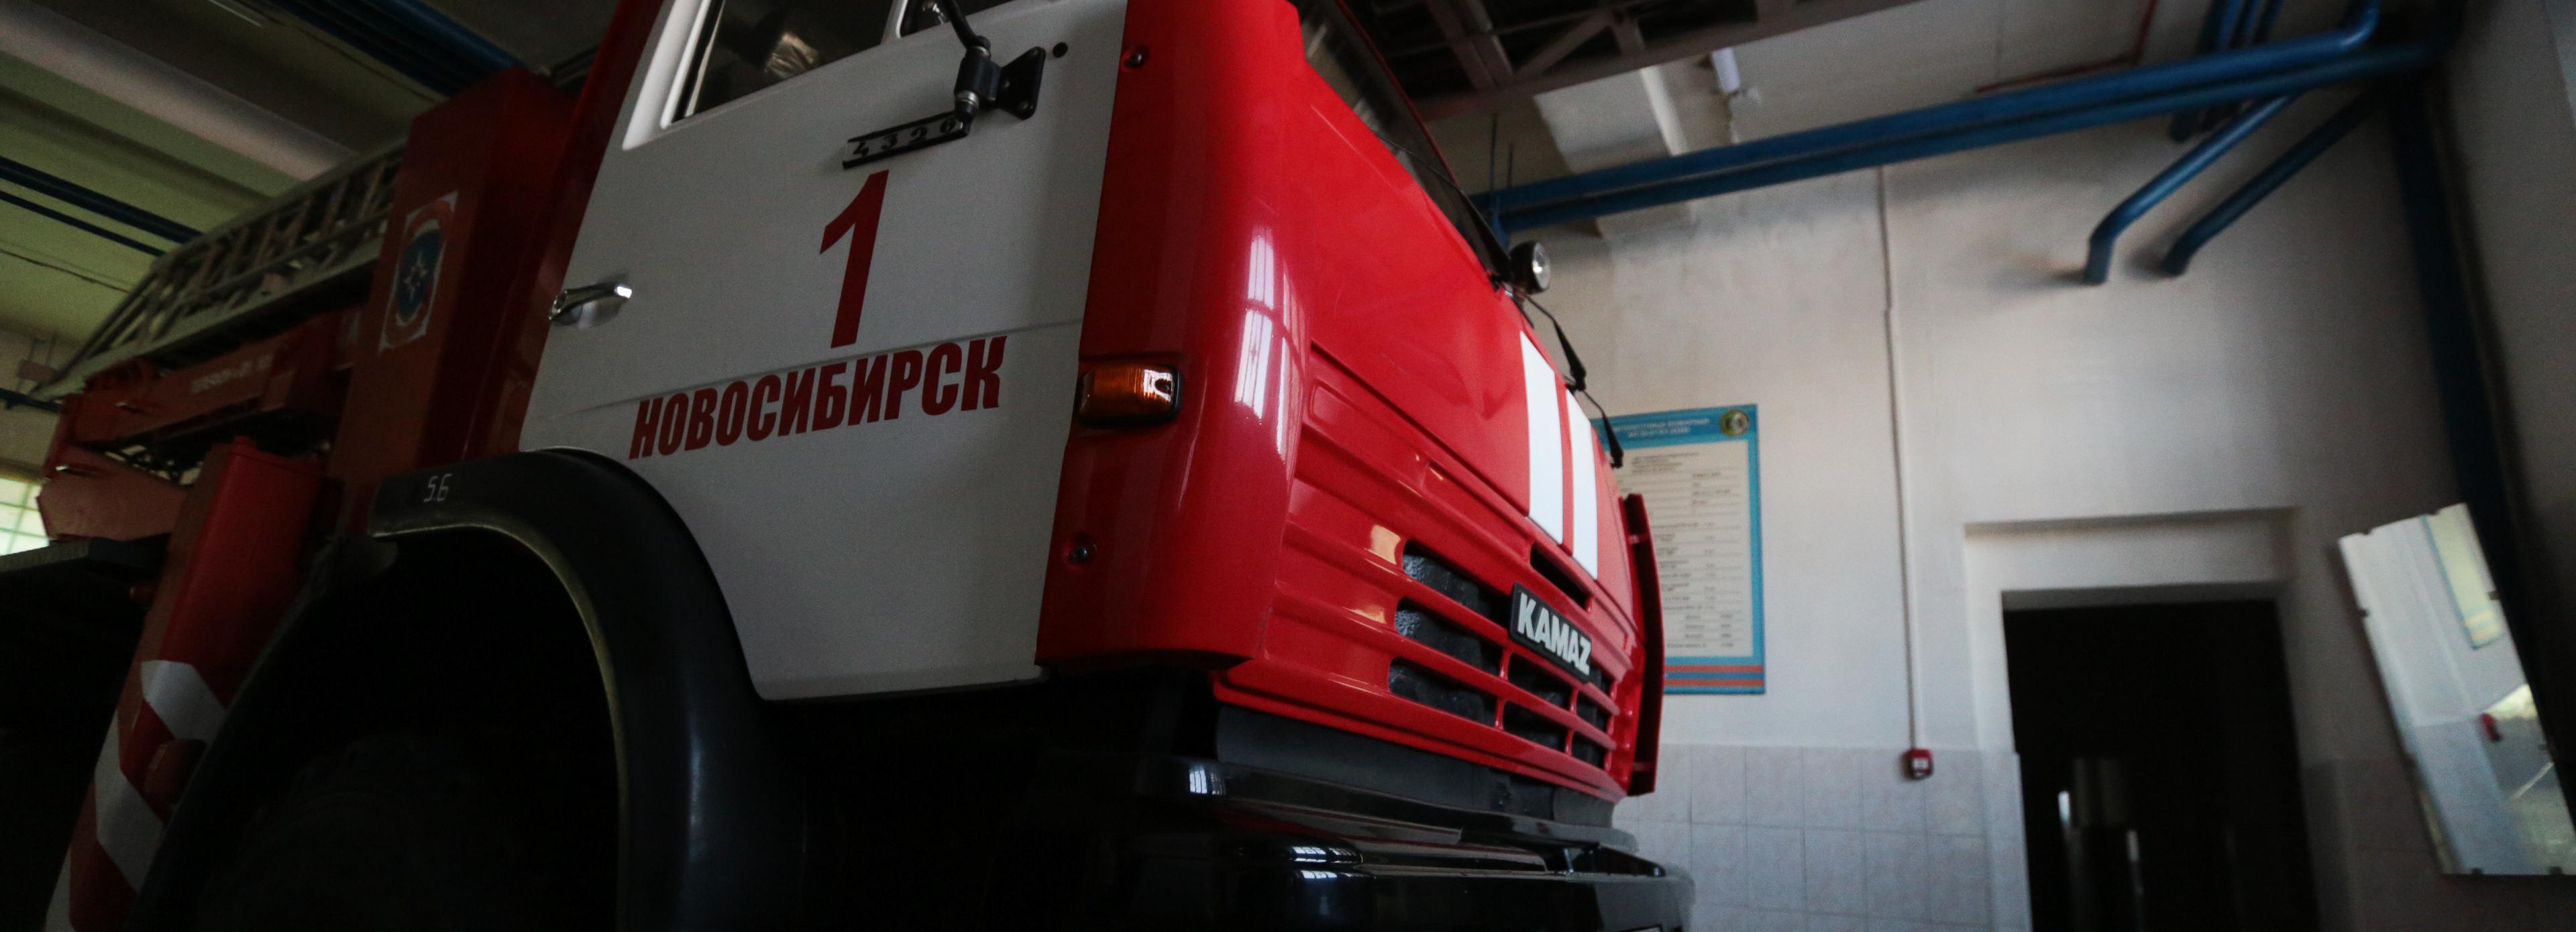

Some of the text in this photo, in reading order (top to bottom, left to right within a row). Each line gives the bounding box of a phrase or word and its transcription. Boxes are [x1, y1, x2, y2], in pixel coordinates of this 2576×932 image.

[820, 169, 889, 348] 1
[629, 336, 1008, 460] НОВОСИБИРСК
[1517, 592, 1592, 676] KAMAZ
